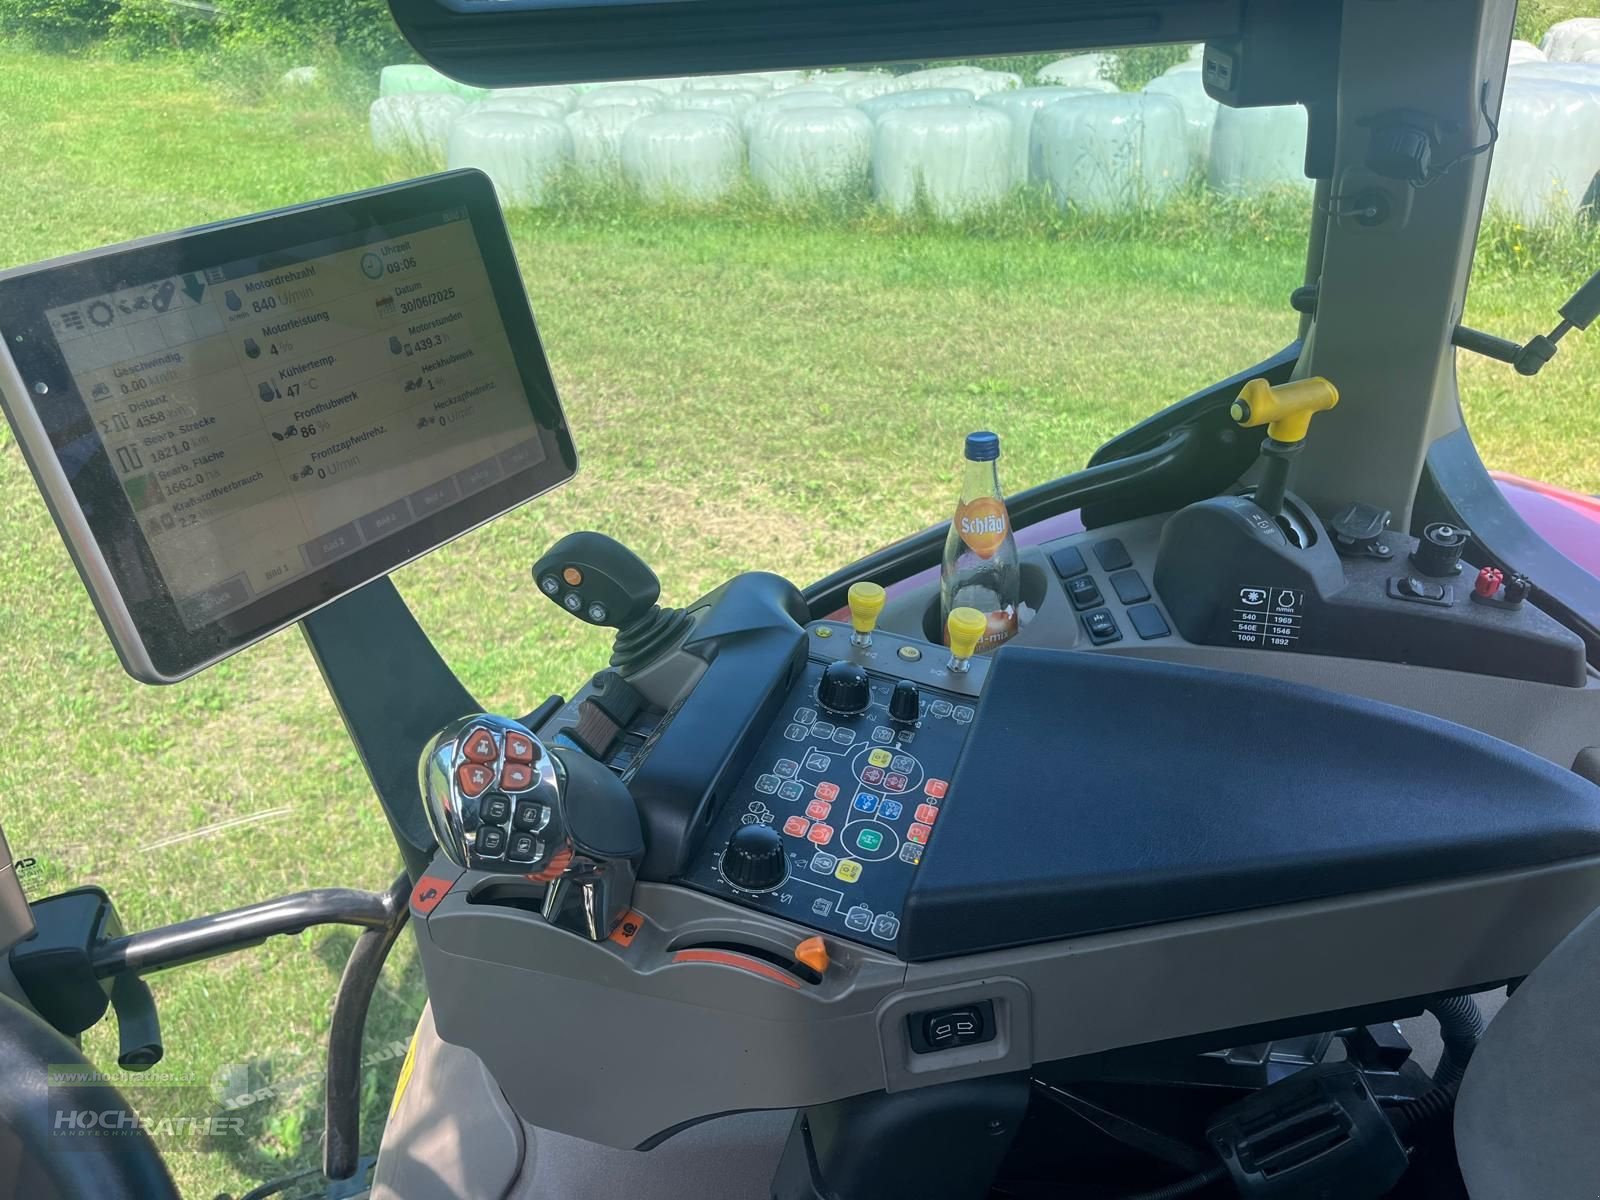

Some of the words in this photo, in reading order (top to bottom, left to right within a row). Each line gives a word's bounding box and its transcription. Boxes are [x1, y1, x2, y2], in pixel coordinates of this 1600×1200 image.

[245, 266, 316, 293] Motordrehzahl
[395, 282, 422, 296] Datum
[252, 296, 277, 313] 840
[400, 288, 456, 314] 30/06/2025
[262, 310, 330, 337] Motorleistung
[409, 311, 463, 336] Motorstunden
[270, 344, 279, 355] 4
[415, 334, 442, 353] 439.3
[279, 354, 337, 379] Kühlertemp.
[422, 349, 474, 373] Heckhubwerk
[120, 378, 148, 395] 0.00
[287, 383, 301, 398] 47
[128, 394, 168, 413] Distanz
[294, 390, 359, 421] Fronthubwerk
[136, 411, 166, 429] 4558
[179, 415, 216, 435] Strecke
[301, 424, 317, 439] 86
[317, 468, 326, 480] 0
[327, 455, 360, 476] U/min
[961, 513, 1006, 535] Schlägl
[1238, 623, 1258, 632] 540E
[1242, 613, 1257, 621] 540
[1274, 616, 1293, 625] 1969
[1238, 634, 1256, 642] 1000
[1271, 637, 1289, 646] 1892
